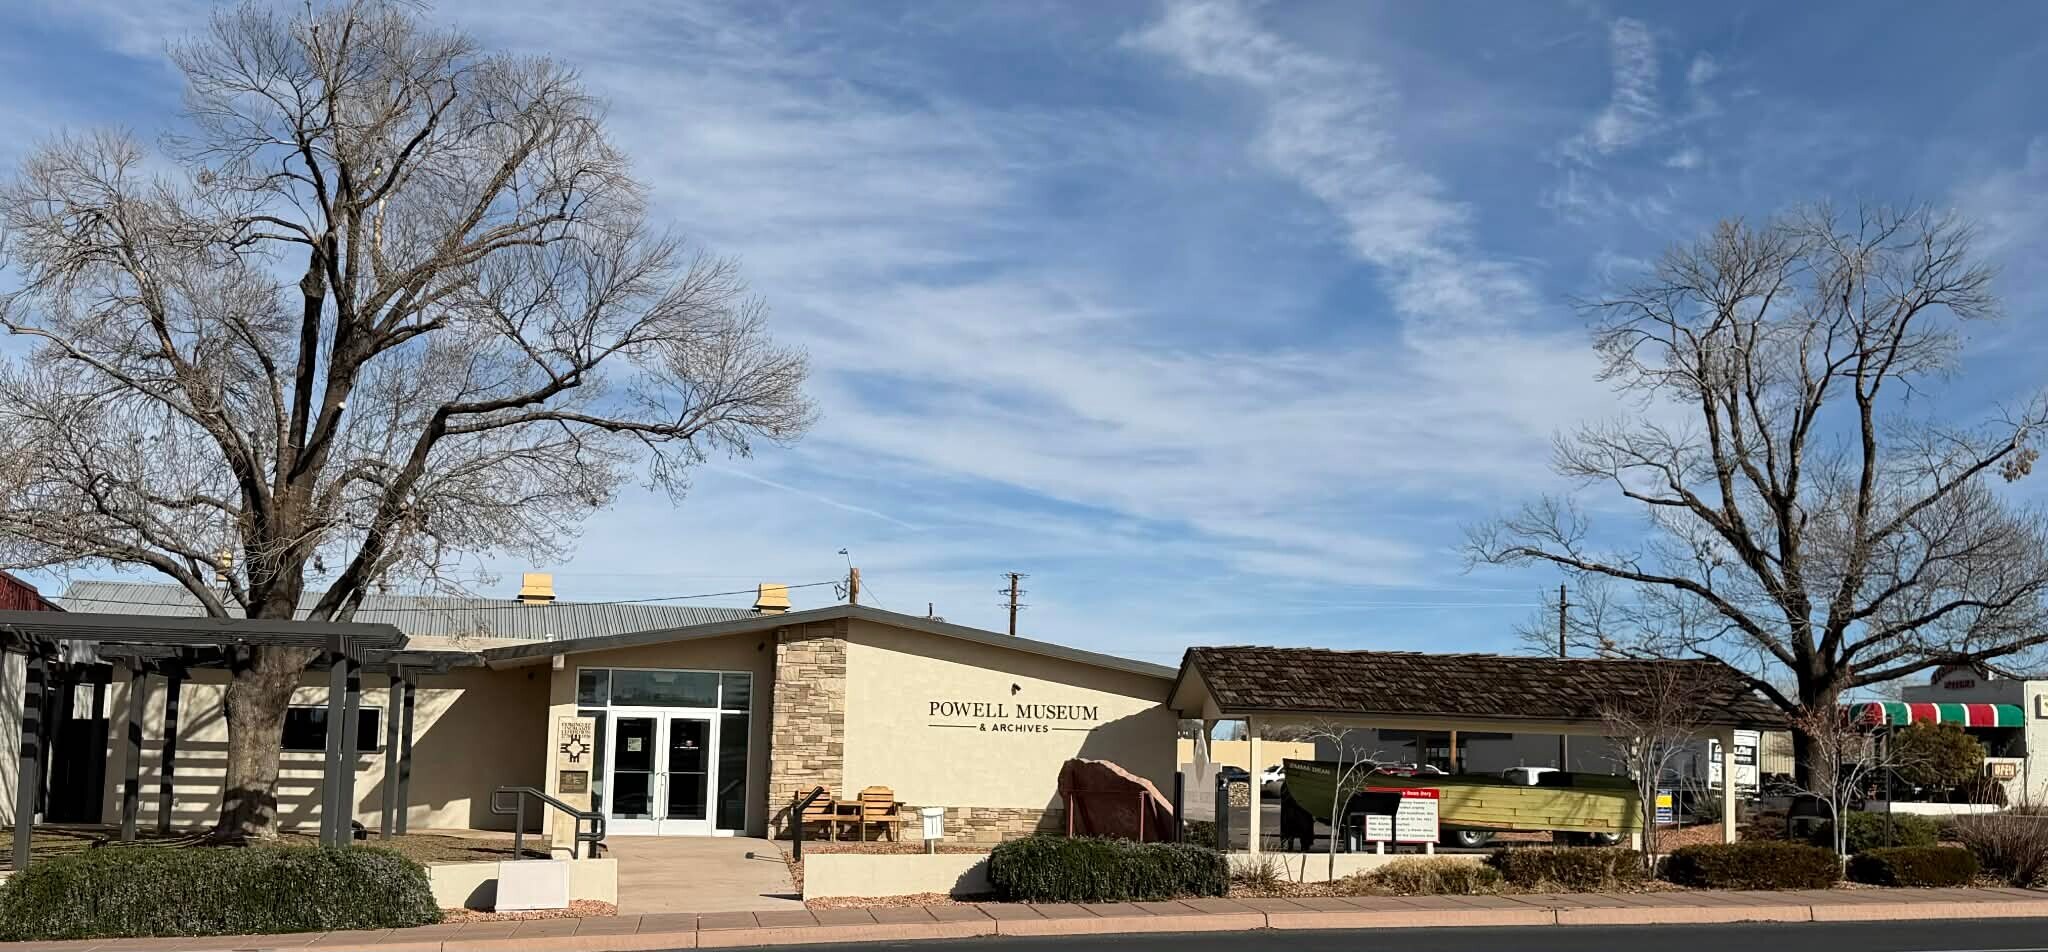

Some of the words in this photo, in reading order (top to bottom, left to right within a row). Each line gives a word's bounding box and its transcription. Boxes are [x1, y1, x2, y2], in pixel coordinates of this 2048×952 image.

[928, 701, 1009, 718] POWELL
[1016, 703, 1098, 721] MUSEUM
[979, 723, 987, 732] &
[992, 724, 1049, 733] ARCHIVES
[1994, 764, 2015, 776] OPEN
